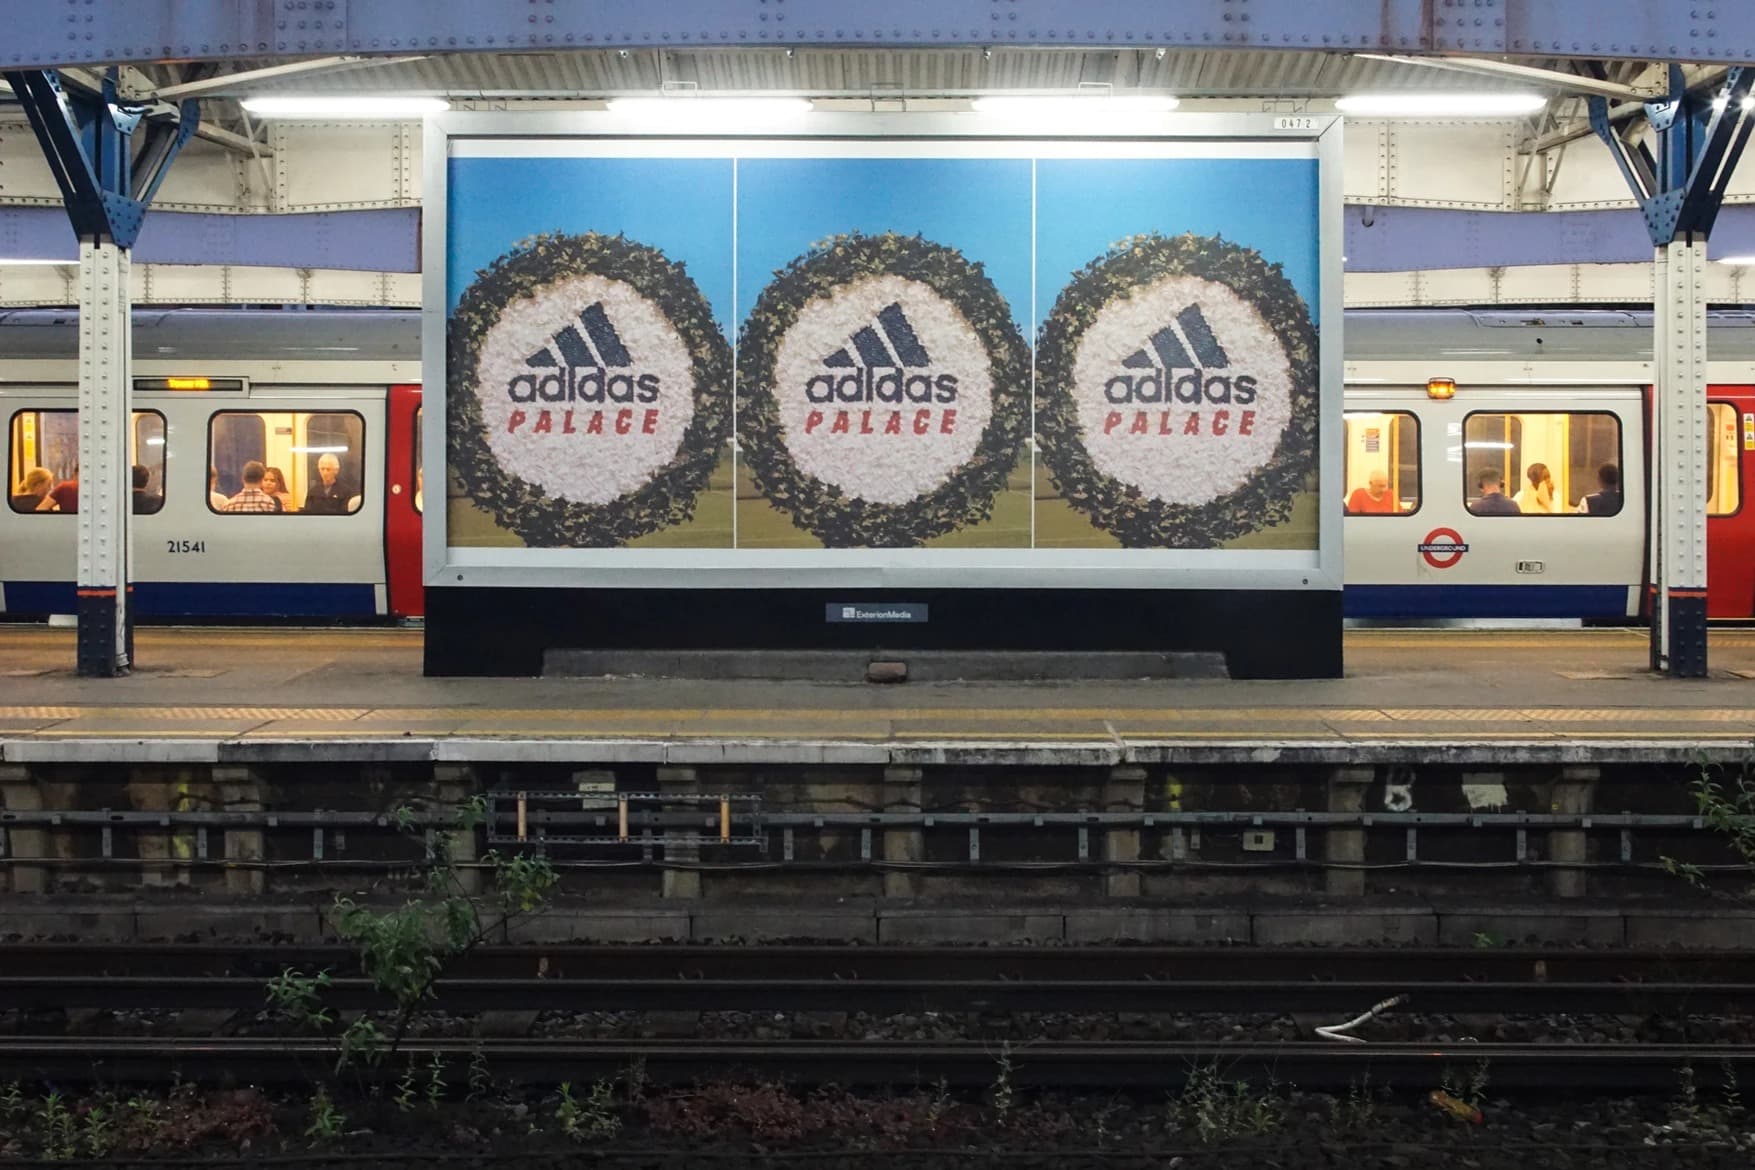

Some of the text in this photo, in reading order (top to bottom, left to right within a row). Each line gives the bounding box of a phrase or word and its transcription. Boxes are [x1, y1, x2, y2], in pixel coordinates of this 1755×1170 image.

[508, 367, 660, 403] adidas
[805, 367, 958, 403] adidas
[1104, 368, 1258, 404] adidas
[507, 408, 659, 435] PALACE
[805, 409, 957, 435] PALACE
[1103, 409, 1256, 436] PALACE
[167, 540, 205, 553] 21541
[856, 610, 911, 619] ExterionMedia
